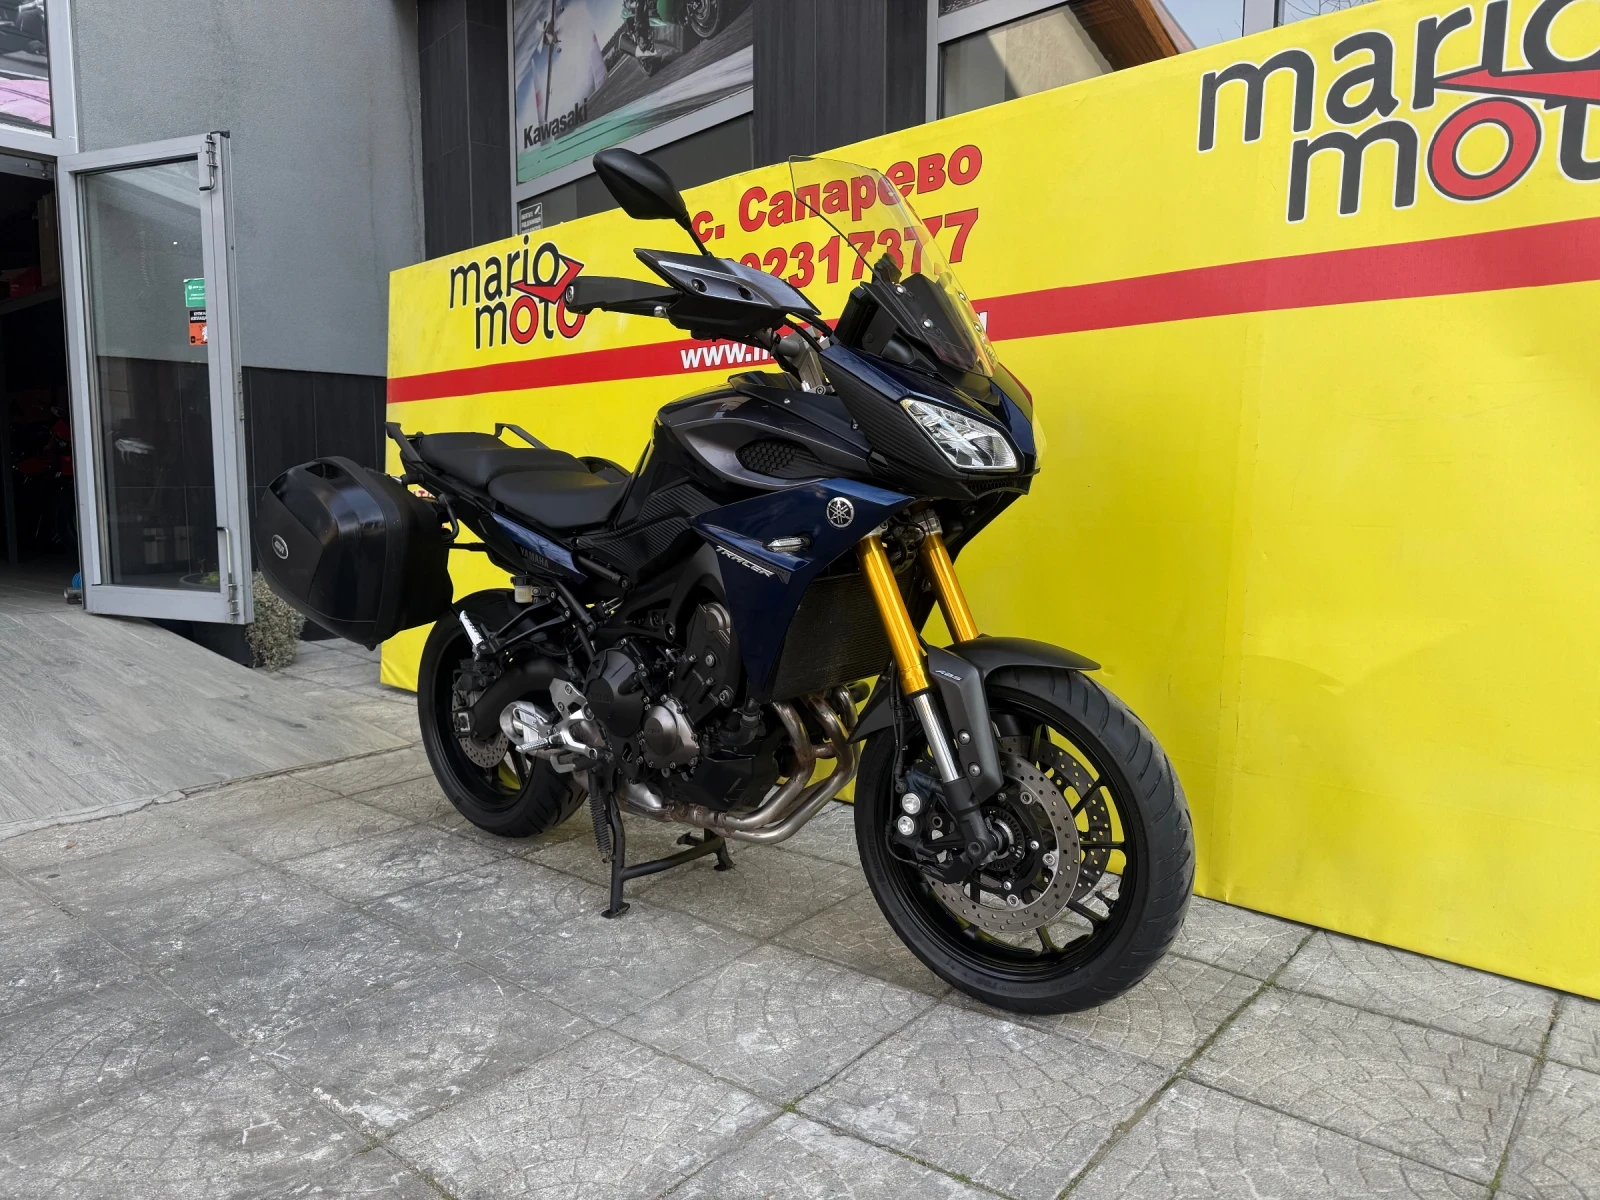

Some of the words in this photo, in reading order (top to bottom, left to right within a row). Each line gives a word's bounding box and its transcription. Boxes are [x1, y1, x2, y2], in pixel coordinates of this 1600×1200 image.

[523, 97, 588, 149] Kawasaki
[738, 143, 983, 233] Сапарево
[449, 234, 560, 310] mario
[475, 294, 587, 350] moto
[519, 546, 549, 569] YAMAHA
[715, 545, 775, 578] TRACER
